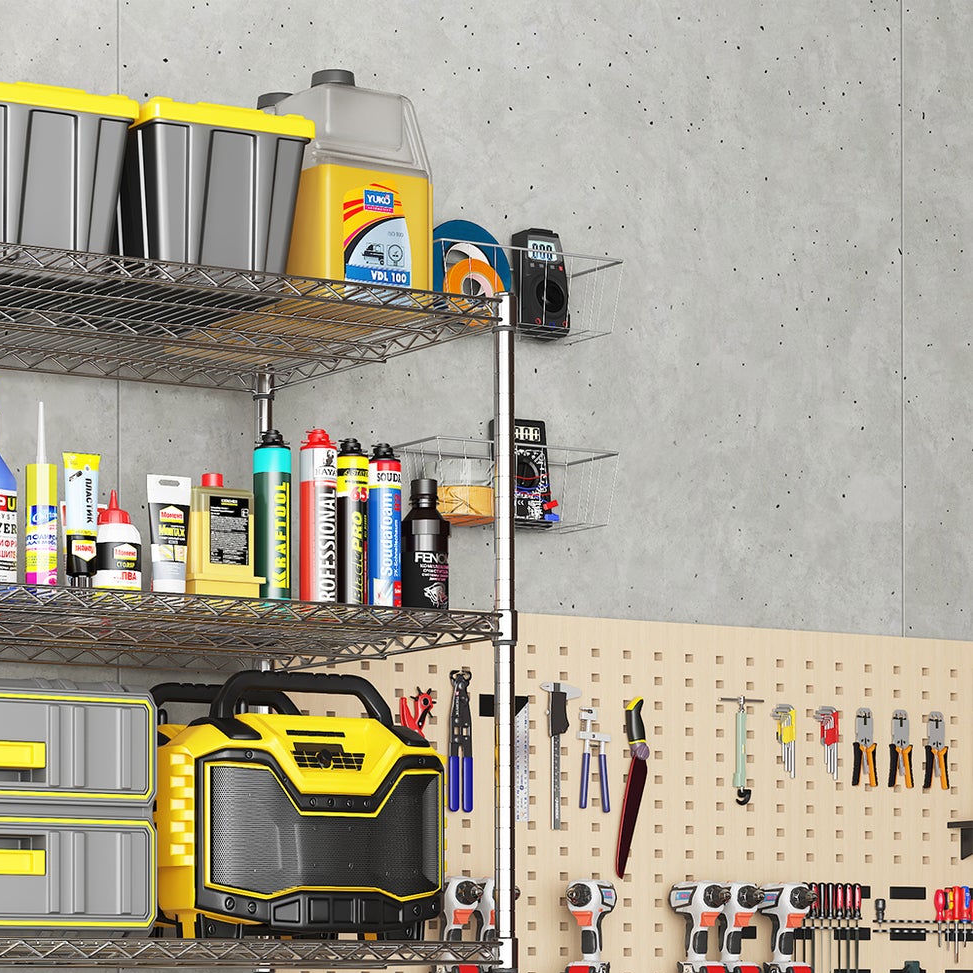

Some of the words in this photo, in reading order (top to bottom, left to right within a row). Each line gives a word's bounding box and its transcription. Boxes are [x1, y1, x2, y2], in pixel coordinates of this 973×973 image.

[367, 194, 390, 205] YUKO
[370, 270, 388, 281] VDL
[391, 273, 407, 283] 100
[350, 486, 368, 502] 65
[273, 481, 287, 588] KRAFTOOL
[318, 488, 336, 602] ROFESSIONAL
[379, 492, 393, 577] Soudafoam
